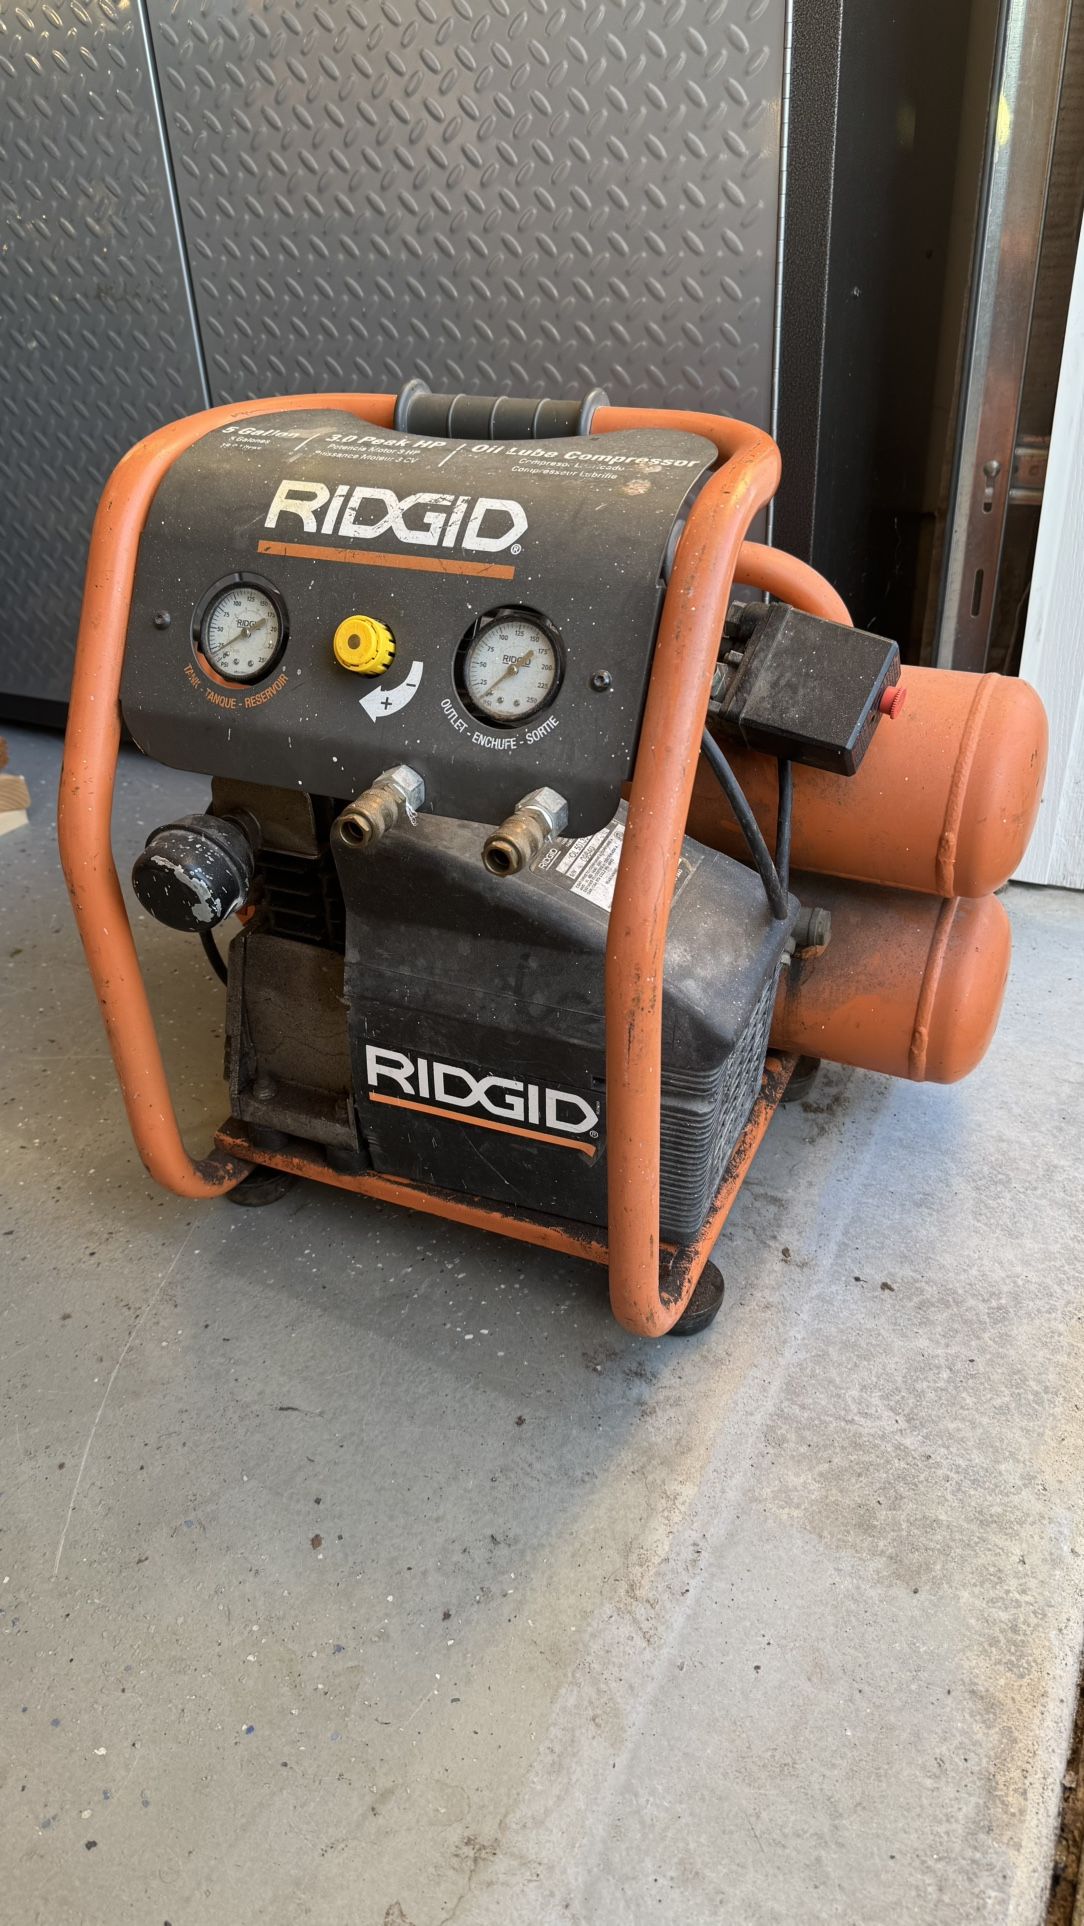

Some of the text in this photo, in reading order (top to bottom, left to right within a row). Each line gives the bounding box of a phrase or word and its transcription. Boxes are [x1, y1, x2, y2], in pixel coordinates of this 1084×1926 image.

[238, 427, 300, 438] Gallon
[325, 434, 447, 448] 3.0 Peak HP
[327, 443, 367, 451] Potencia
[368, 446, 398, 454] Motor
[471, 444, 701, 468] Oil Lube Compressor
[183, 663, 201, 689] TANK
[205, 687, 237, 709] TANQUE
[244, 673, 289, 709] RESERVOIR
[440, 698, 468, 733] OUTLET
[472, 731, 517, 750] ENCHUFE
[525, 715, 560, 745] SORTIE
[365, 1044, 599, 1133] RIDGID
